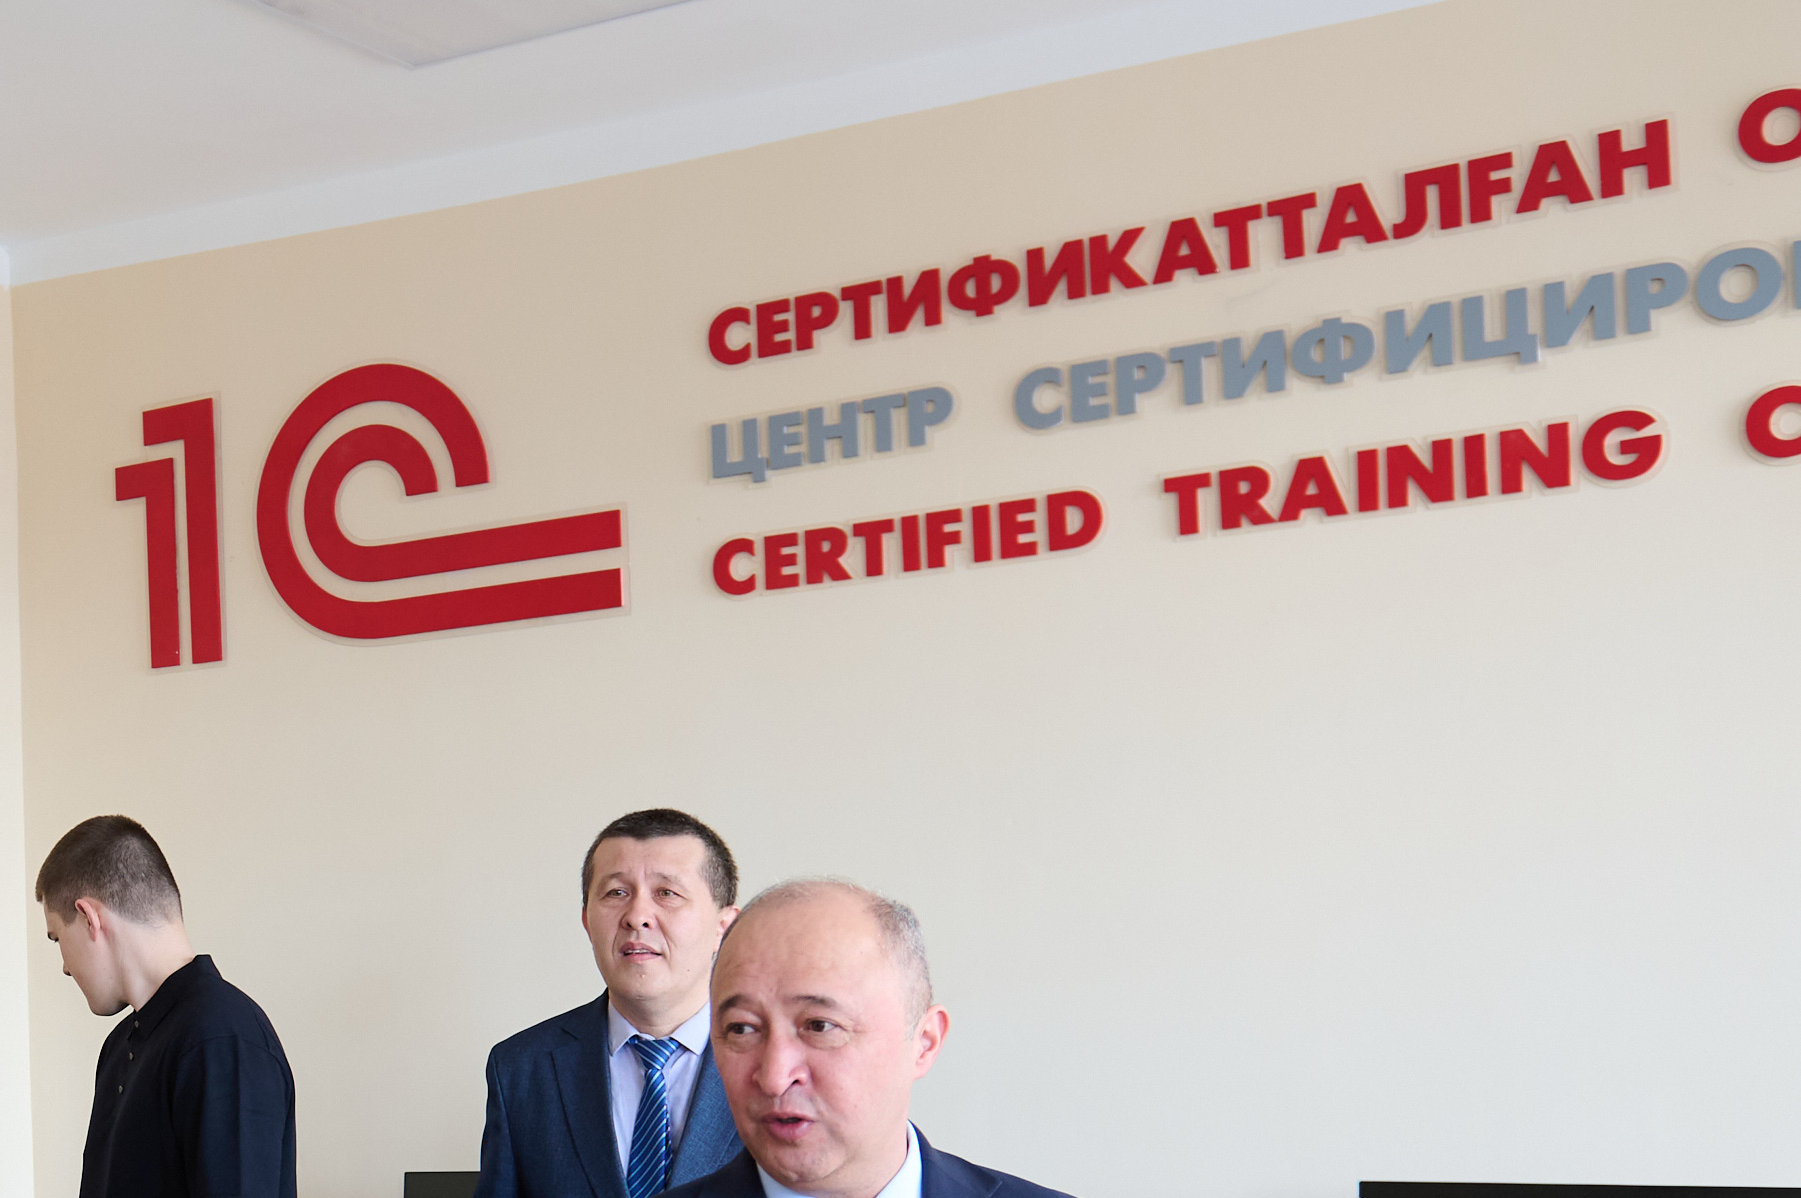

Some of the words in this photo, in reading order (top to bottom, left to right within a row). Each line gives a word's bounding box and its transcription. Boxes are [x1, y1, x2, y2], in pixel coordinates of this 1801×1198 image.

[711, 386, 954, 483] ЦЕНТР
[1014, 239, 1801, 430] СЕРТИФИЦИРО
[713, 490, 1103, 595] CERTIFIED
[1164, 410, 1664, 535] TRAINING
